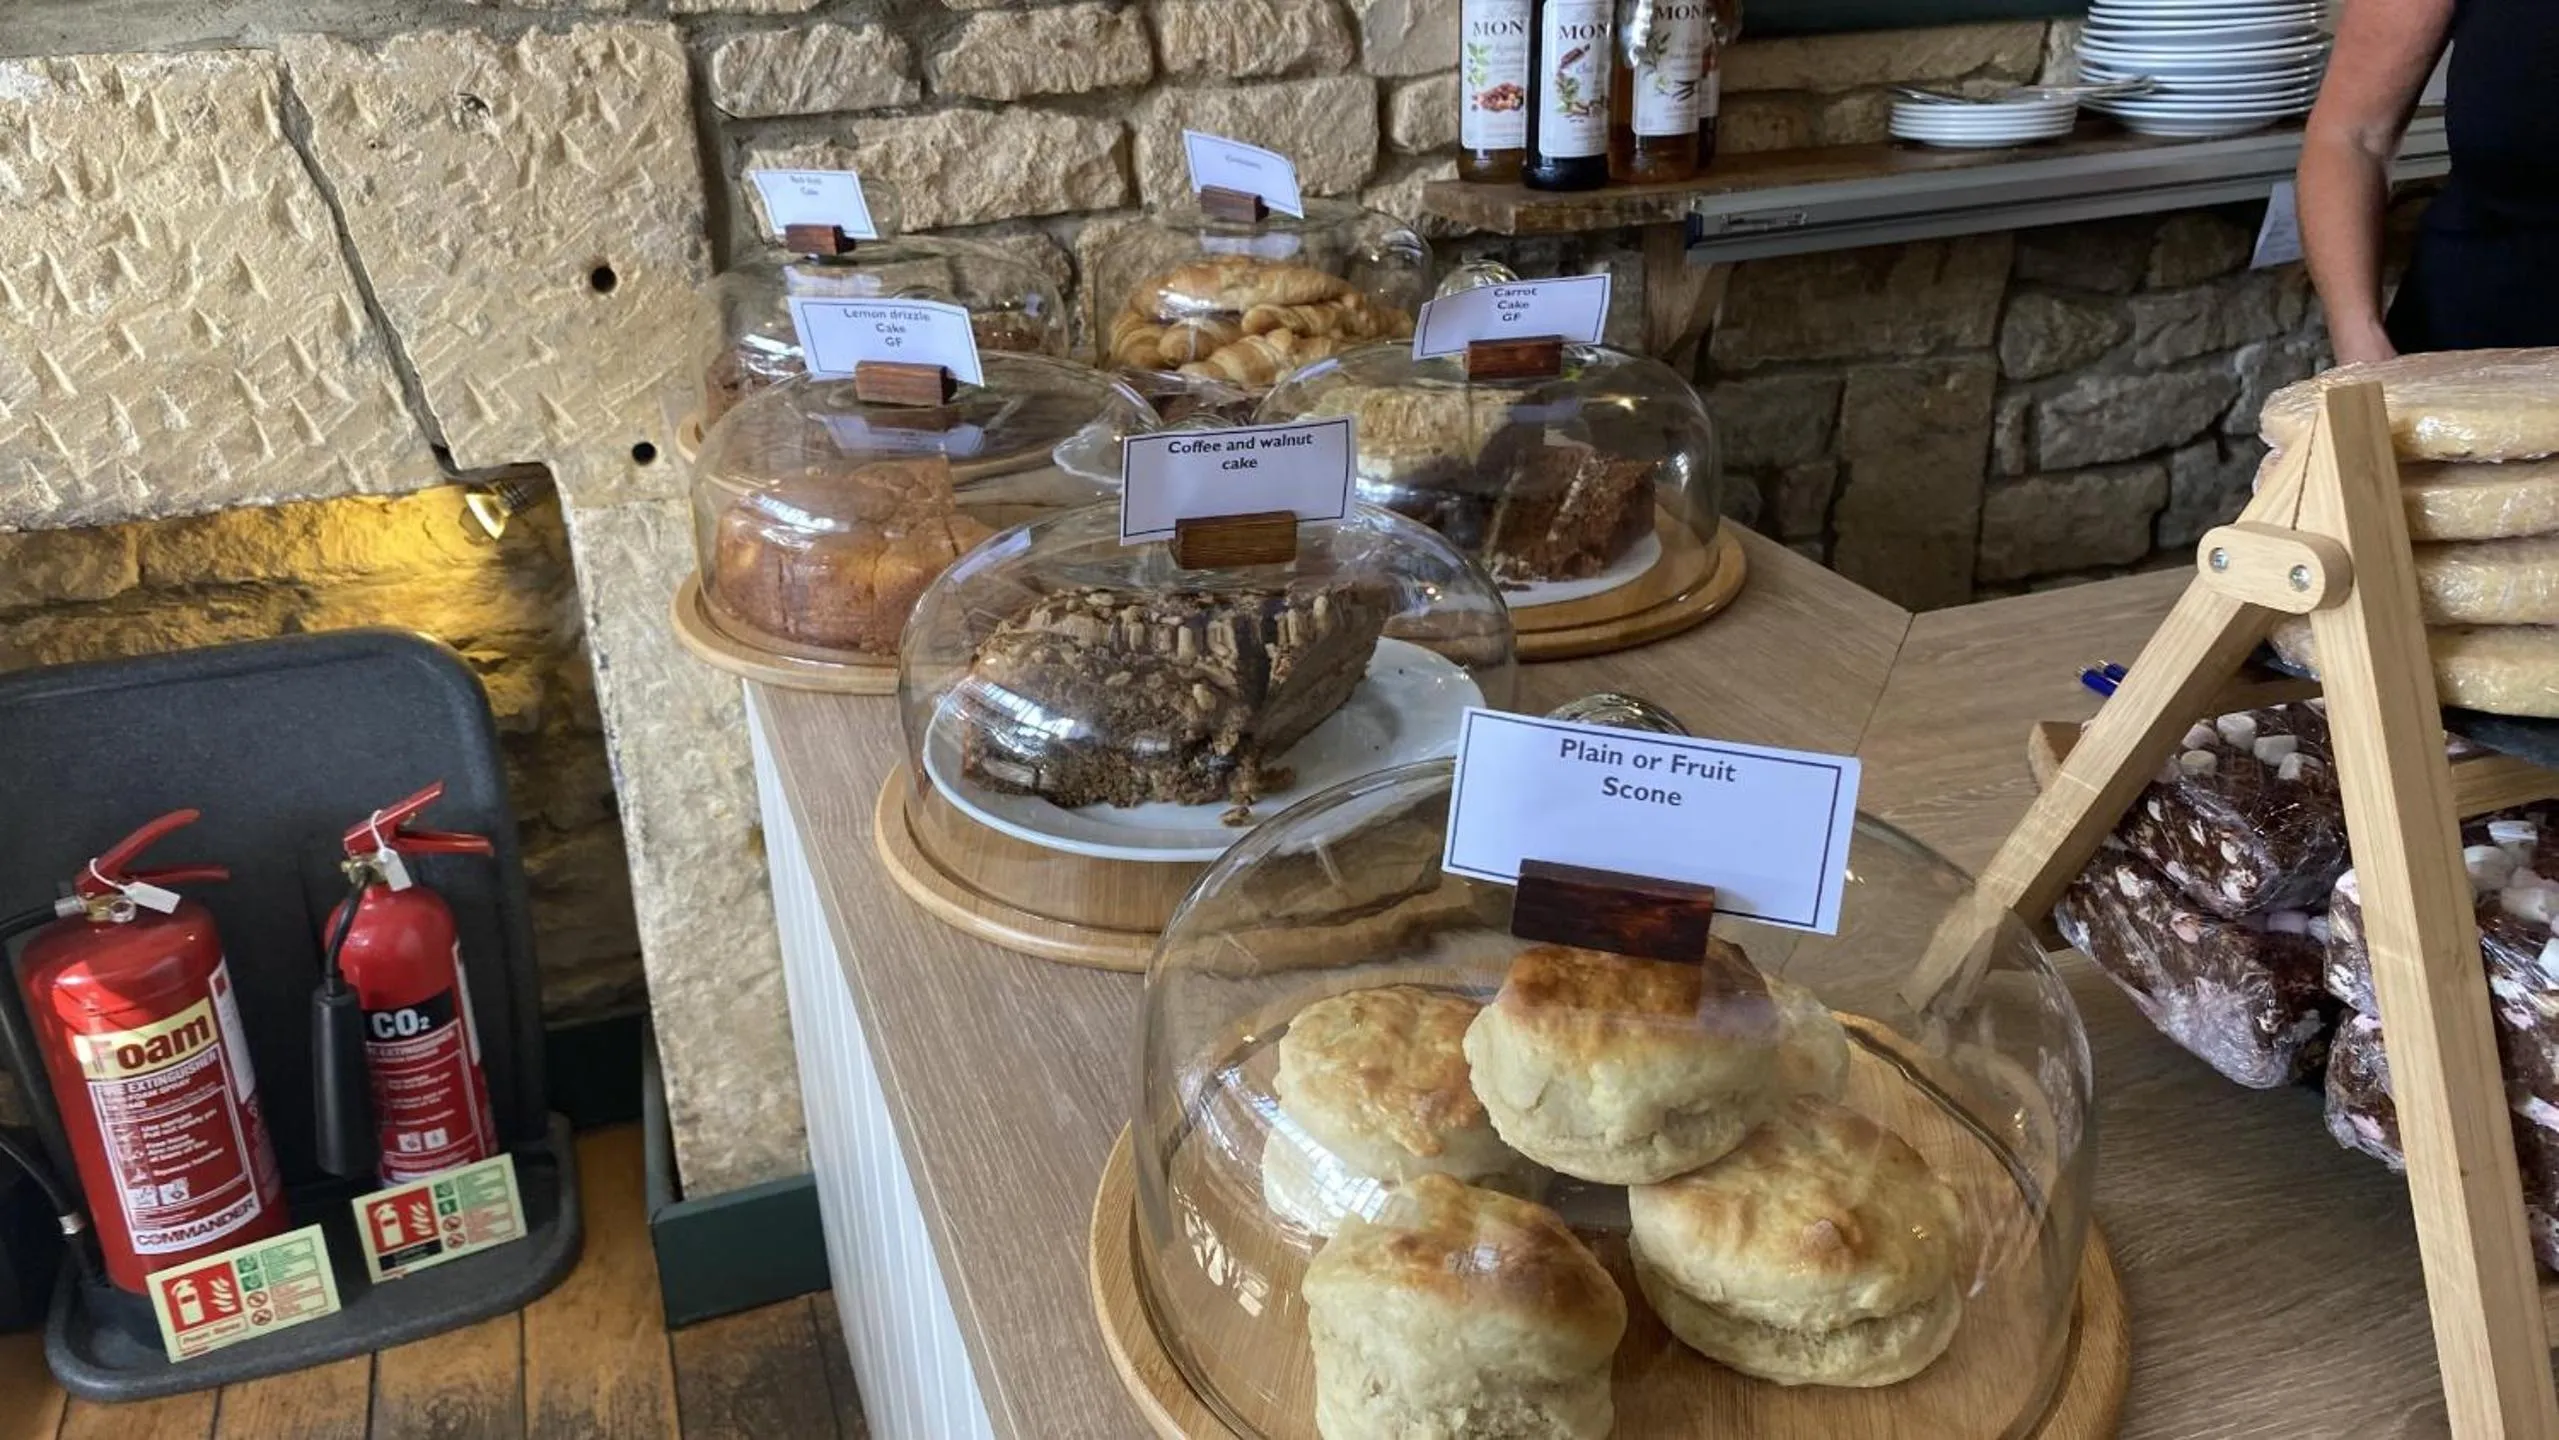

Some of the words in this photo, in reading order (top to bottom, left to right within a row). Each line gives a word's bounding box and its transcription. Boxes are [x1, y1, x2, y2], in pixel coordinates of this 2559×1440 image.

[1493, 287, 1539, 298] Carrot
[1497, 300, 1530, 310] Cake
[843, 308, 887, 319] Lemon
[890, 308, 931, 322] drizzle
[1502, 313, 1521, 322] GF
[875, 323, 907, 334] Cake
[885, 337, 904, 348] GF
[1168, 439, 1222, 454] Coffee
[1226, 436, 1256, 451] and
[1260, 432, 1314, 449] walnut
[1222, 457, 1259, 471] cake
[1560, 738, 1624, 766] Plain
[1632, 752, 1663, 771] or
[1670, 753, 1737, 783] Fruit
[1601, 776, 1683, 807] Scone
[89, 1015, 211, 1074] Foam
[136, 1199, 256, 1247] COMMANDER
